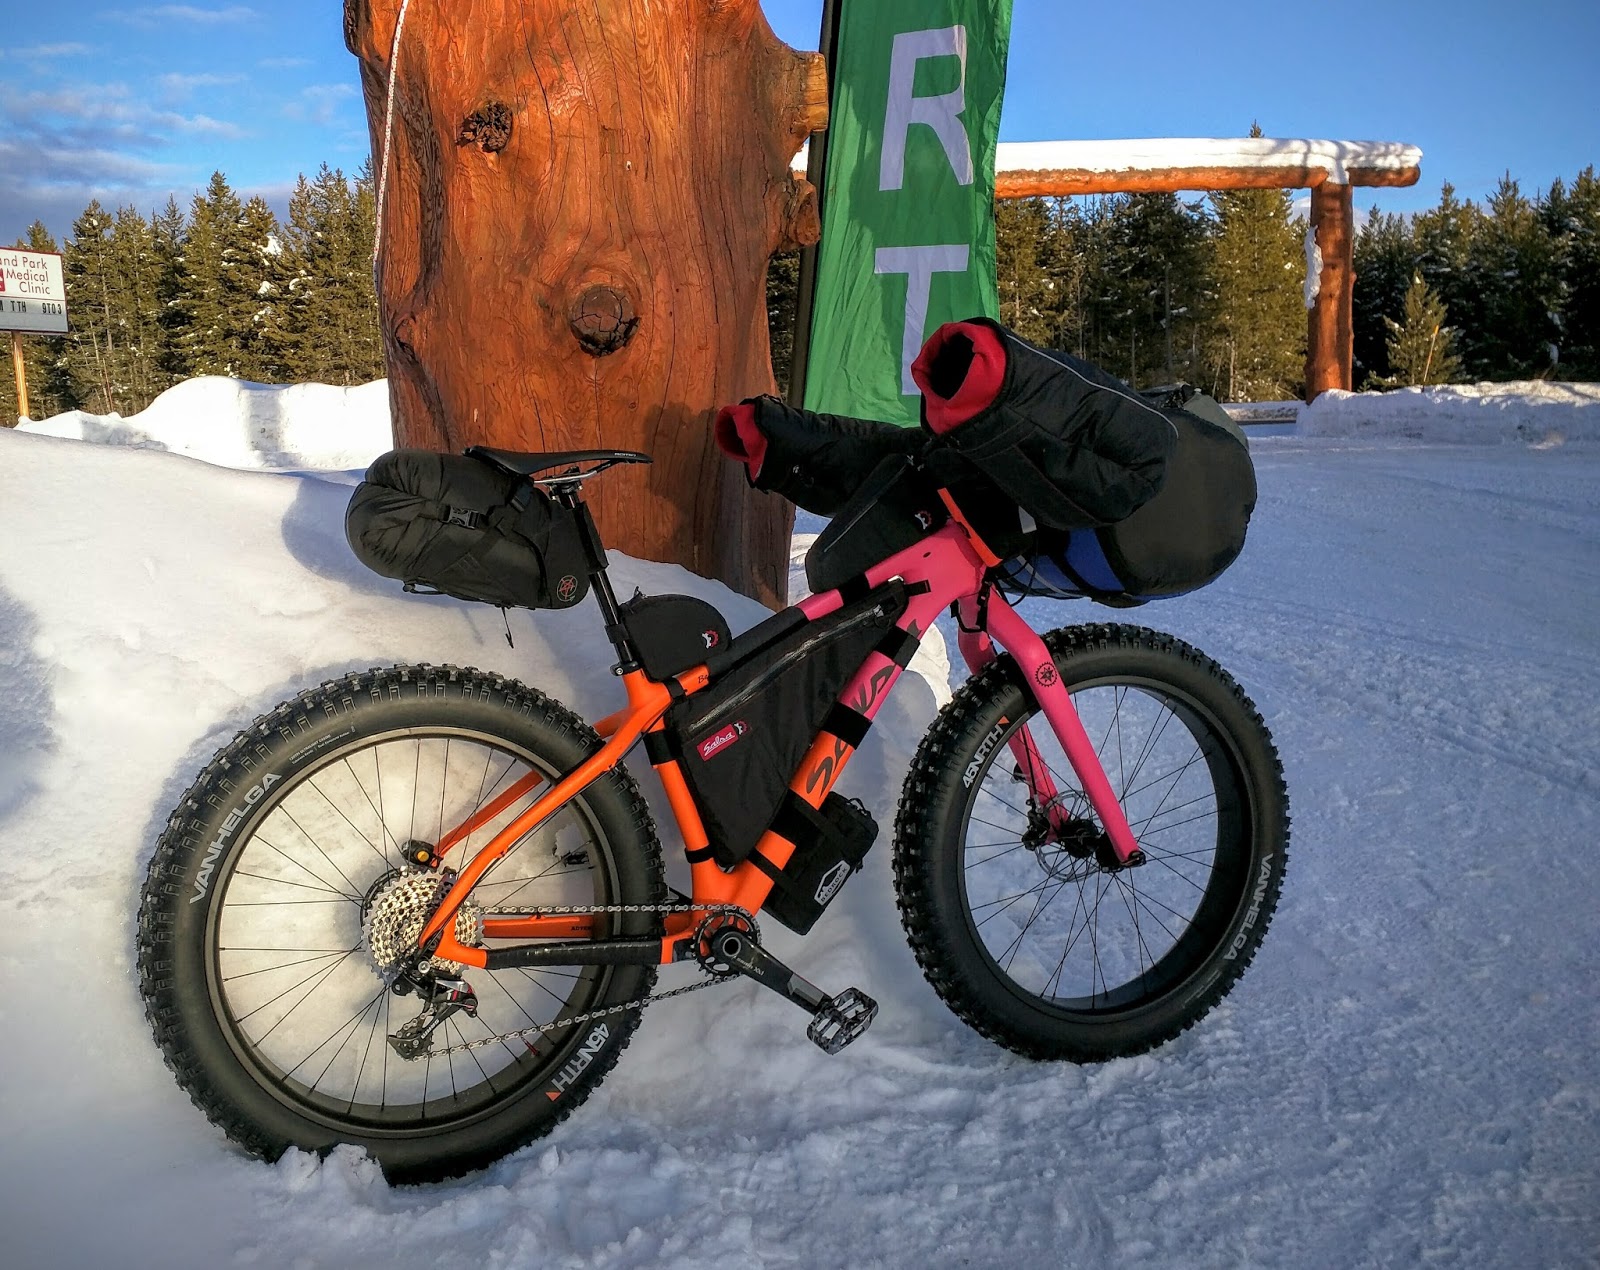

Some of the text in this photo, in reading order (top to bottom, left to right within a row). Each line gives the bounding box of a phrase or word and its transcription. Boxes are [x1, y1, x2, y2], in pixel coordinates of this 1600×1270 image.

[6, 267, 49, 282] Medical
[22, 256, 48, 269] Park
[19, 281, 51, 294] Clinic
[703, 731, 736, 757] Salsa
[962, 723, 1004, 789] 45NRTH
[189, 772, 282, 904] VANHELGA
[820, 867, 847, 903] BEDROCK
[1223, 852, 1274, 960] VANHELGA
[551, 1022, 610, 1093] 45NRTH
